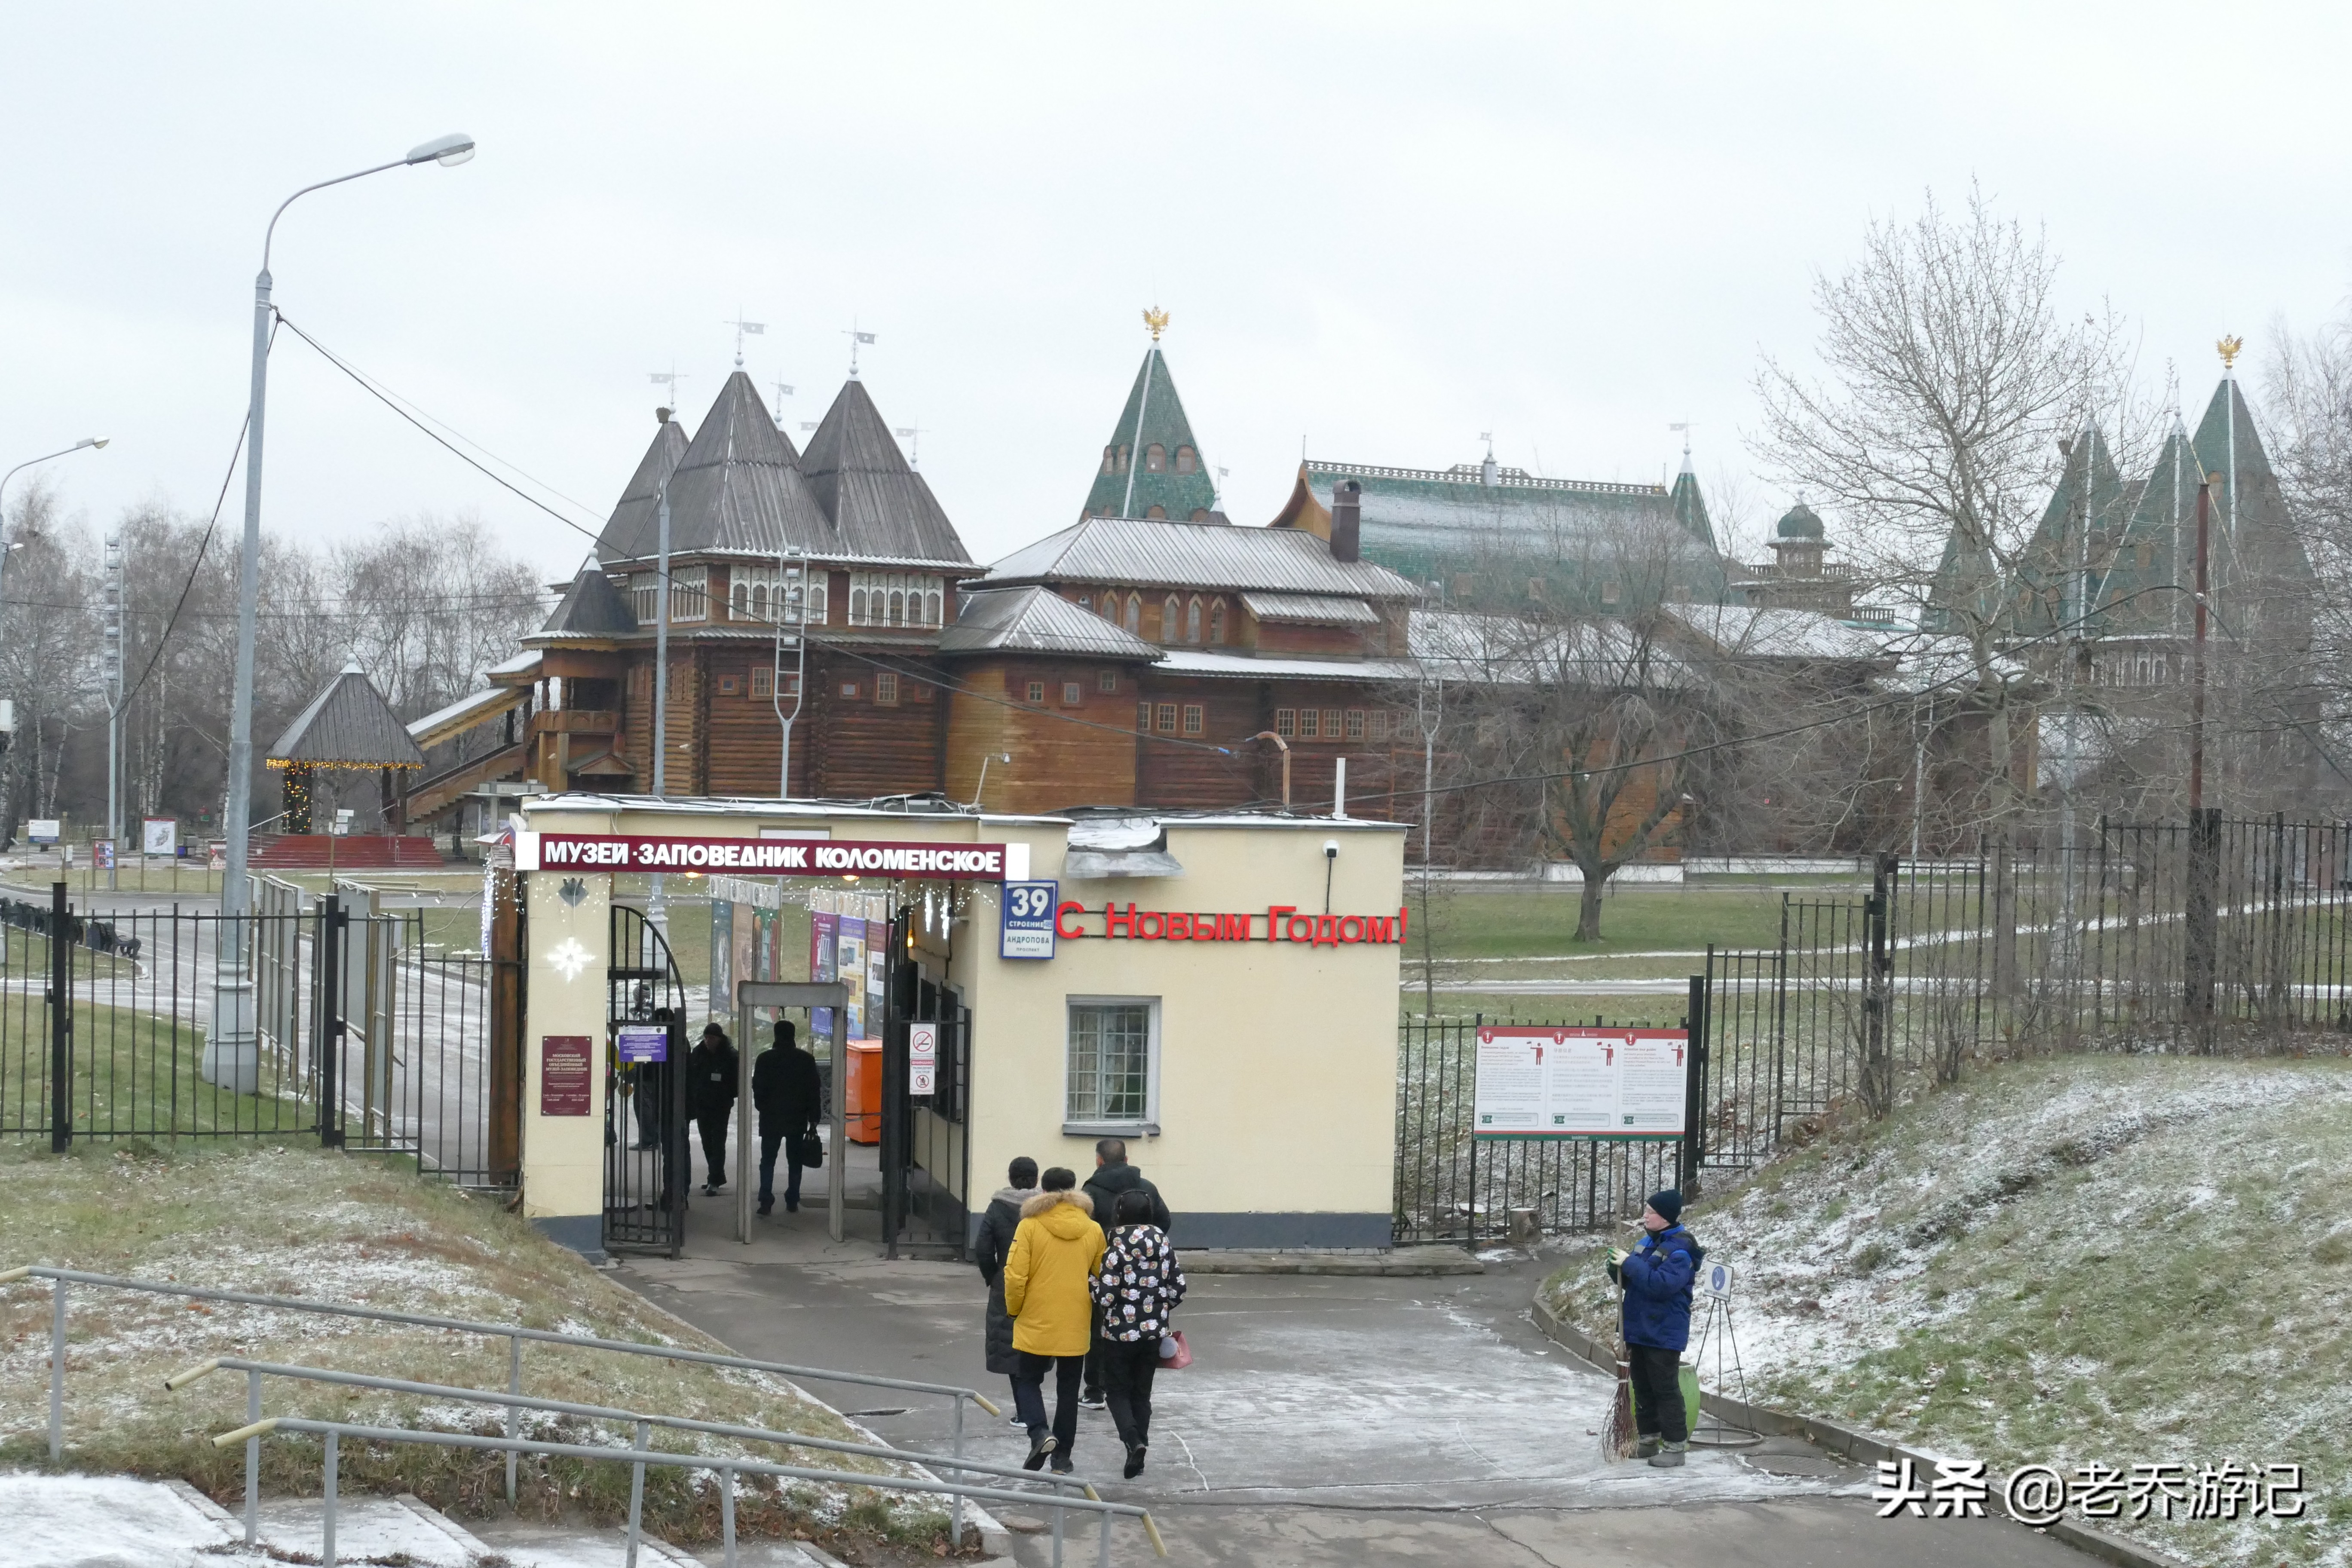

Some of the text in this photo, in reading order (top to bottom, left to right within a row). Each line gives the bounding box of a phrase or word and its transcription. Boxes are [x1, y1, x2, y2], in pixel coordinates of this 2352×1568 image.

[815, 847, 1001, 873] КОЛОМЕНСКОЕ
[1011, 888, 1048, 916] 39
[1056, 901, 1084, 939] С
